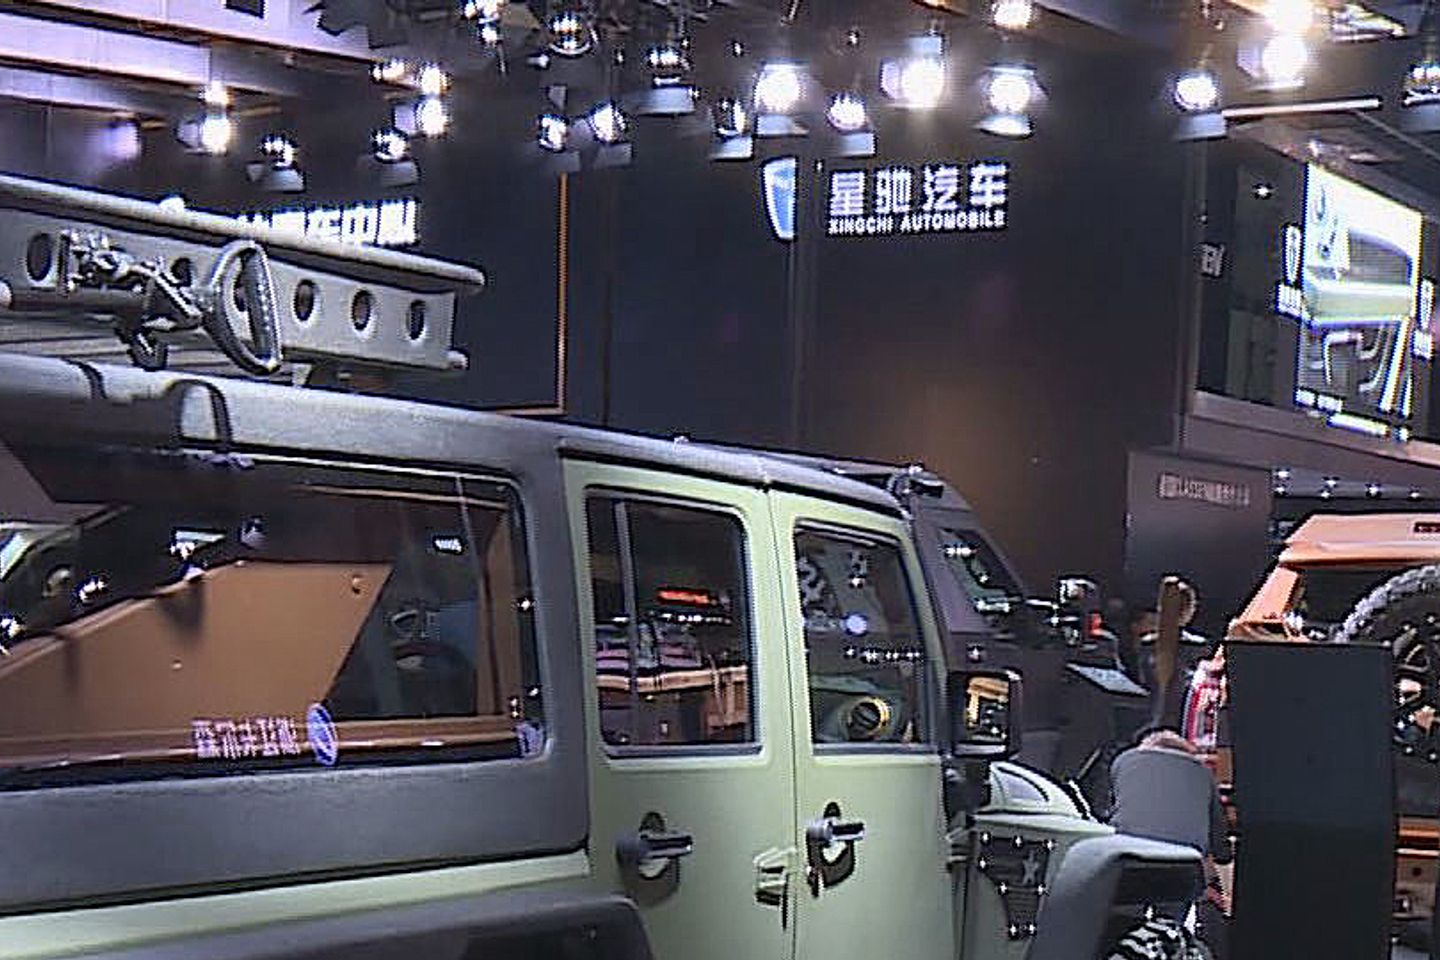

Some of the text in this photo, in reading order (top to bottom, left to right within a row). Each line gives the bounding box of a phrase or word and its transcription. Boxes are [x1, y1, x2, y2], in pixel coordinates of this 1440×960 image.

[830, 163, 1007, 216] 星驰汽车
[828, 209, 1007, 236] XINGCHI AUTOMOBILE
